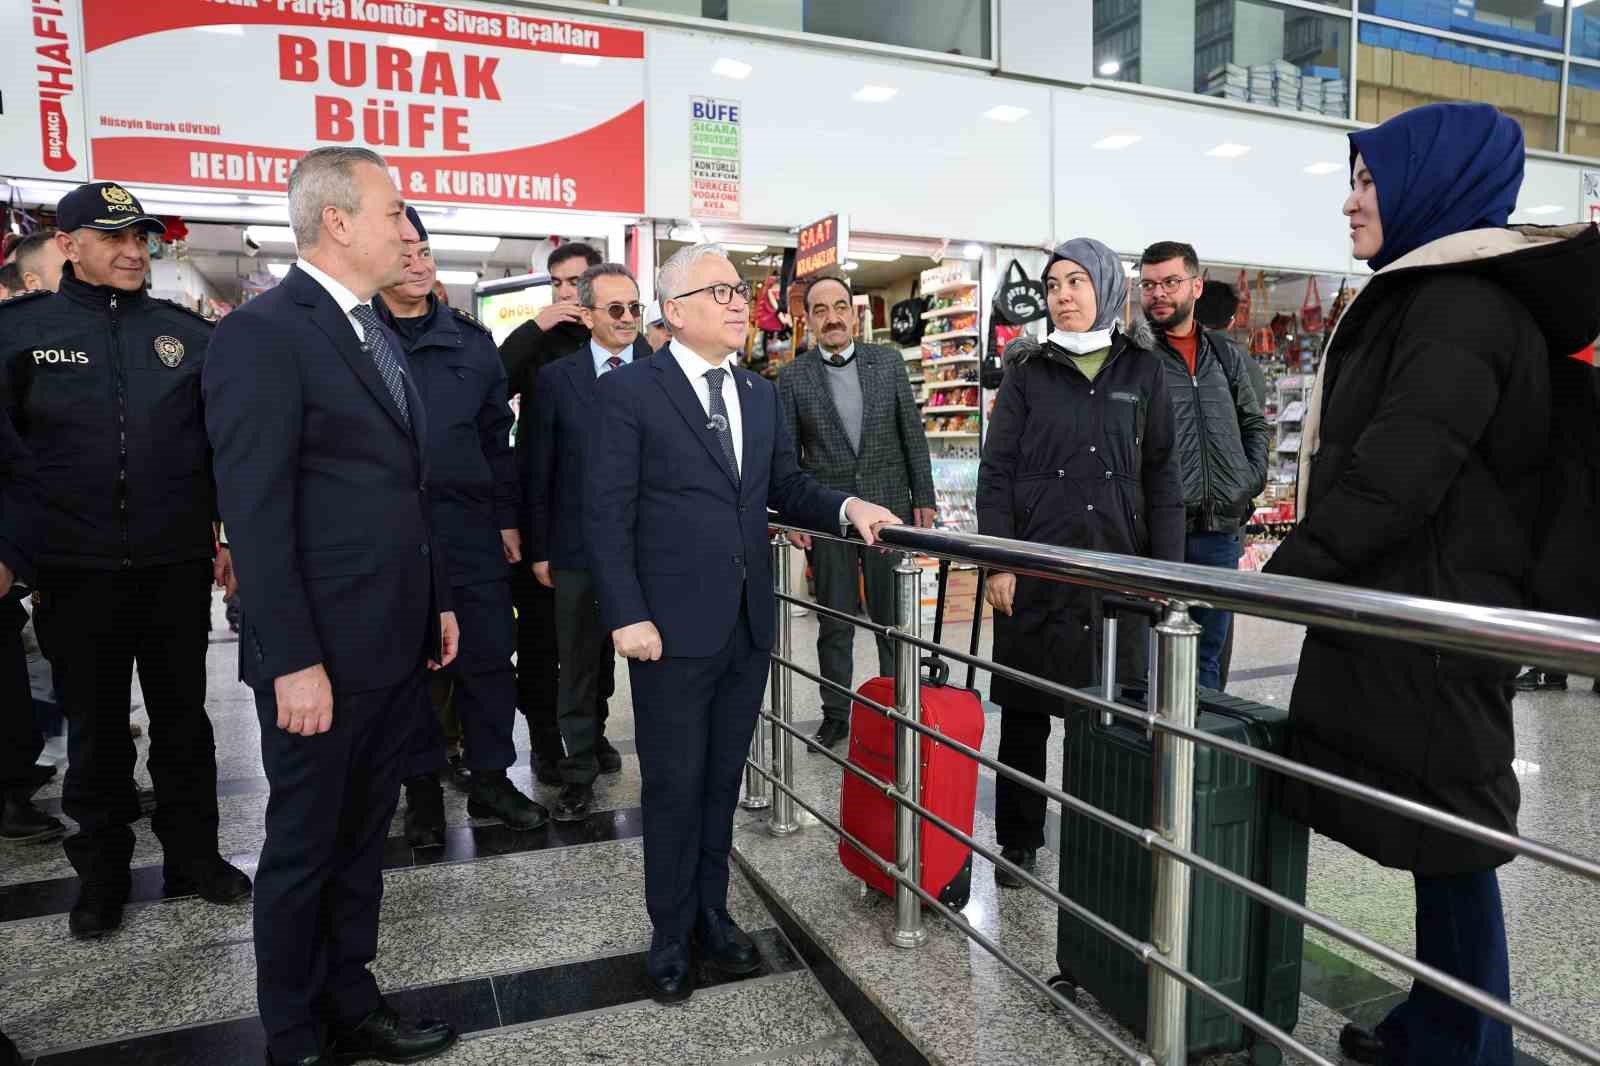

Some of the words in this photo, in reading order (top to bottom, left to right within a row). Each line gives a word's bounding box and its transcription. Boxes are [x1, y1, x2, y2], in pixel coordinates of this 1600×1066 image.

[351, 2, 427, 28] Kontör
[443, 9, 502, 37] Sivas
[507, 17, 600, 48] Bıçakları
[32, 0, 73, 91] HAFI
[278, 34, 501, 100] BURAK
[146, 120, 176, 131] Burak
[693, 97, 739, 122] BÜFE
[409, 170, 427, 192] &
[435, 171, 576, 206] KURUYEMİŞ
[800, 219, 832, 251] SAAT
